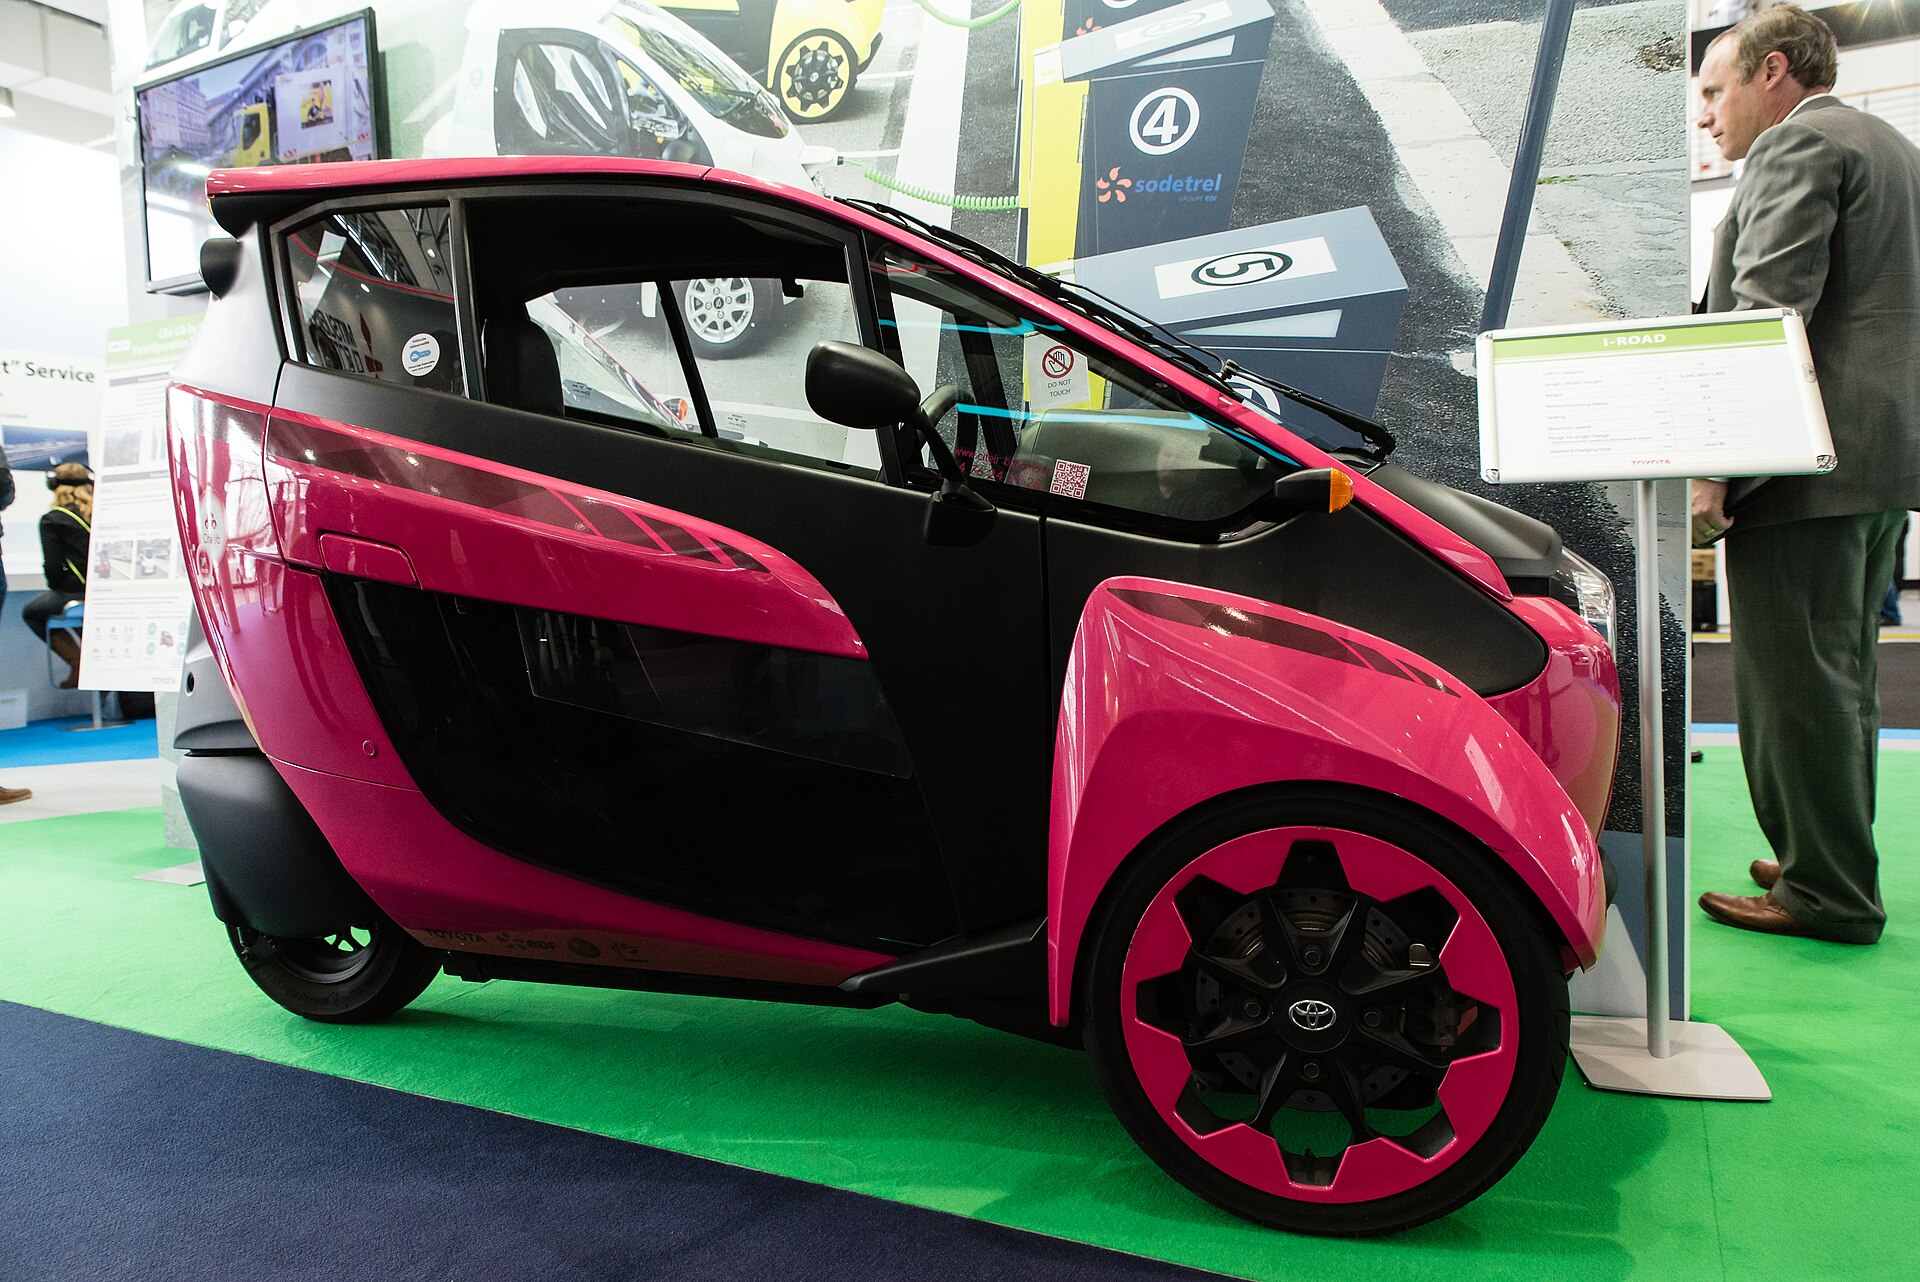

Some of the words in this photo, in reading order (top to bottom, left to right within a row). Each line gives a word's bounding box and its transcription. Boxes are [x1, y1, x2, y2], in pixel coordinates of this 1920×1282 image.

[1142, 98, 1179, 144] 4
[1135, 173, 1222, 193] sodetrel
[1205, 258, 1276, 279] 5
[1603, 333, 1667, 347] i-ROAD
[25, 361, 95, 383] Service
[1048, 381, 1057, 389] DO
[1059, 379, 1071, 387] NOT
[1050, 389, 1071, 397] TOUCH
[423, 928, 488, 944] TOYOTA
